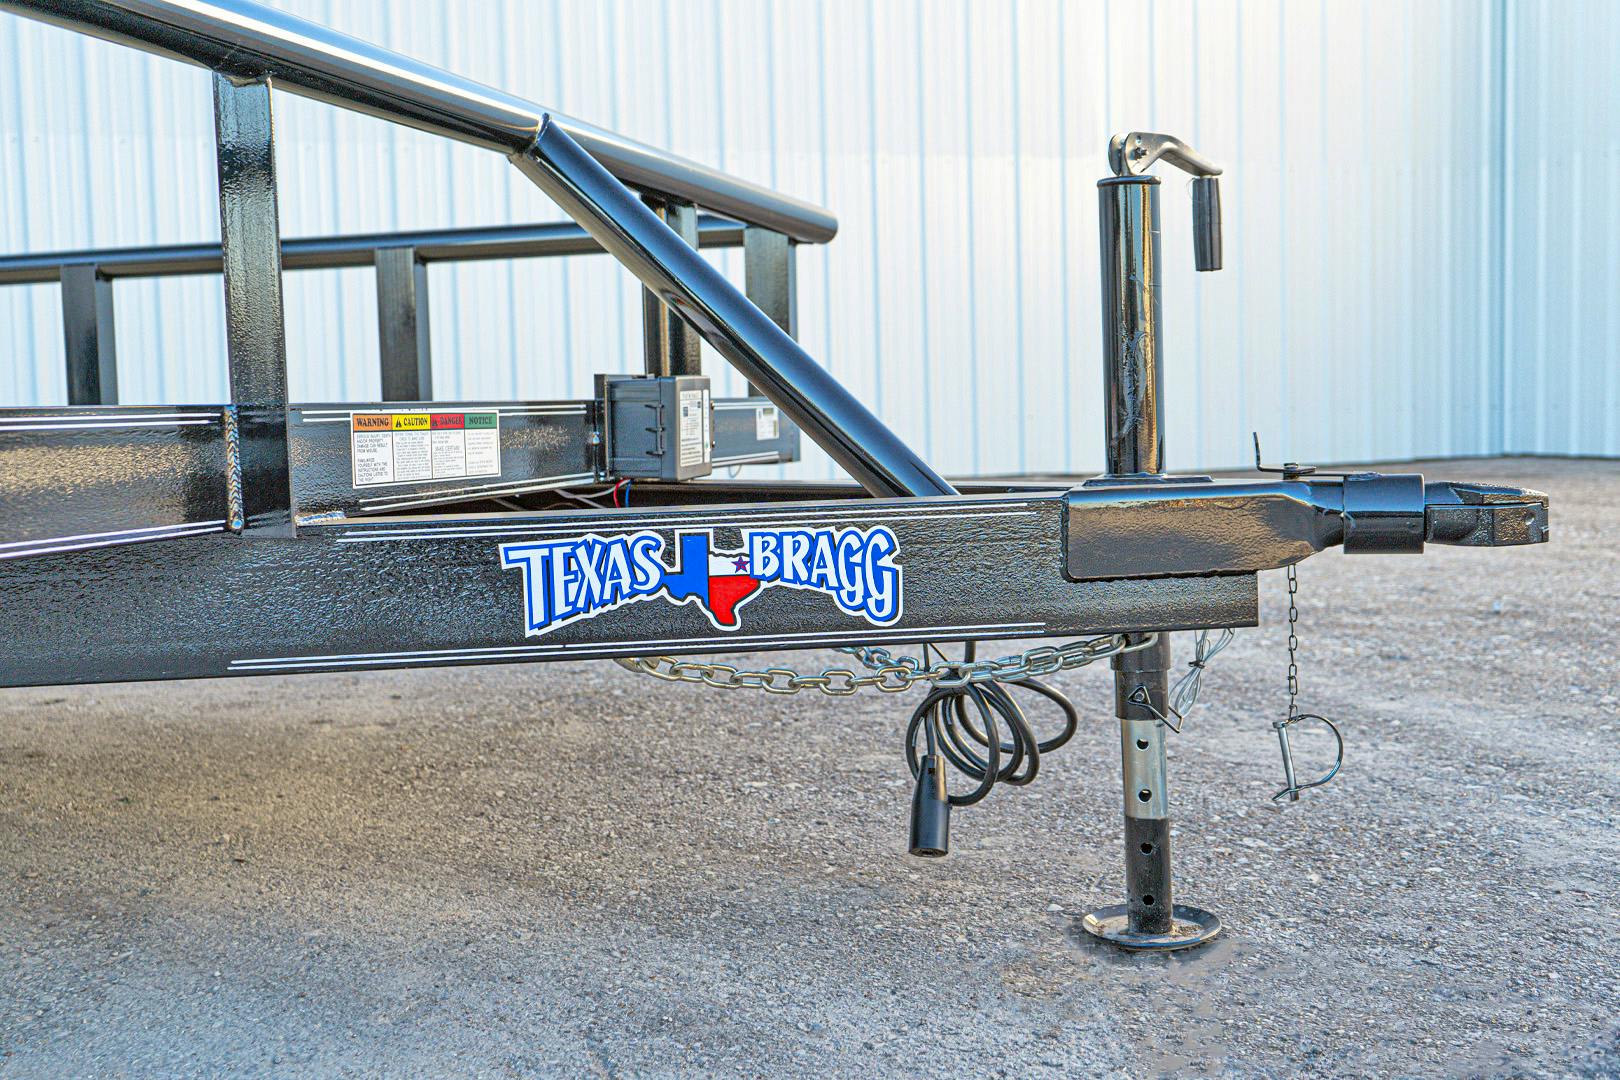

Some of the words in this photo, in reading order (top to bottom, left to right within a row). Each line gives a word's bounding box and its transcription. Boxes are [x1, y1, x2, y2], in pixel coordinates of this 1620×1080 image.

[356, 417, 389, 427] WARNING
[403, 417, 428, 426] CAUTION
[440, 416, 463, 425] DANGER
[468, 415, 493, 425] NOTICE
[501, 529, 664, 631] TEXAS
[750, 529, 899, 623] BRAGG
